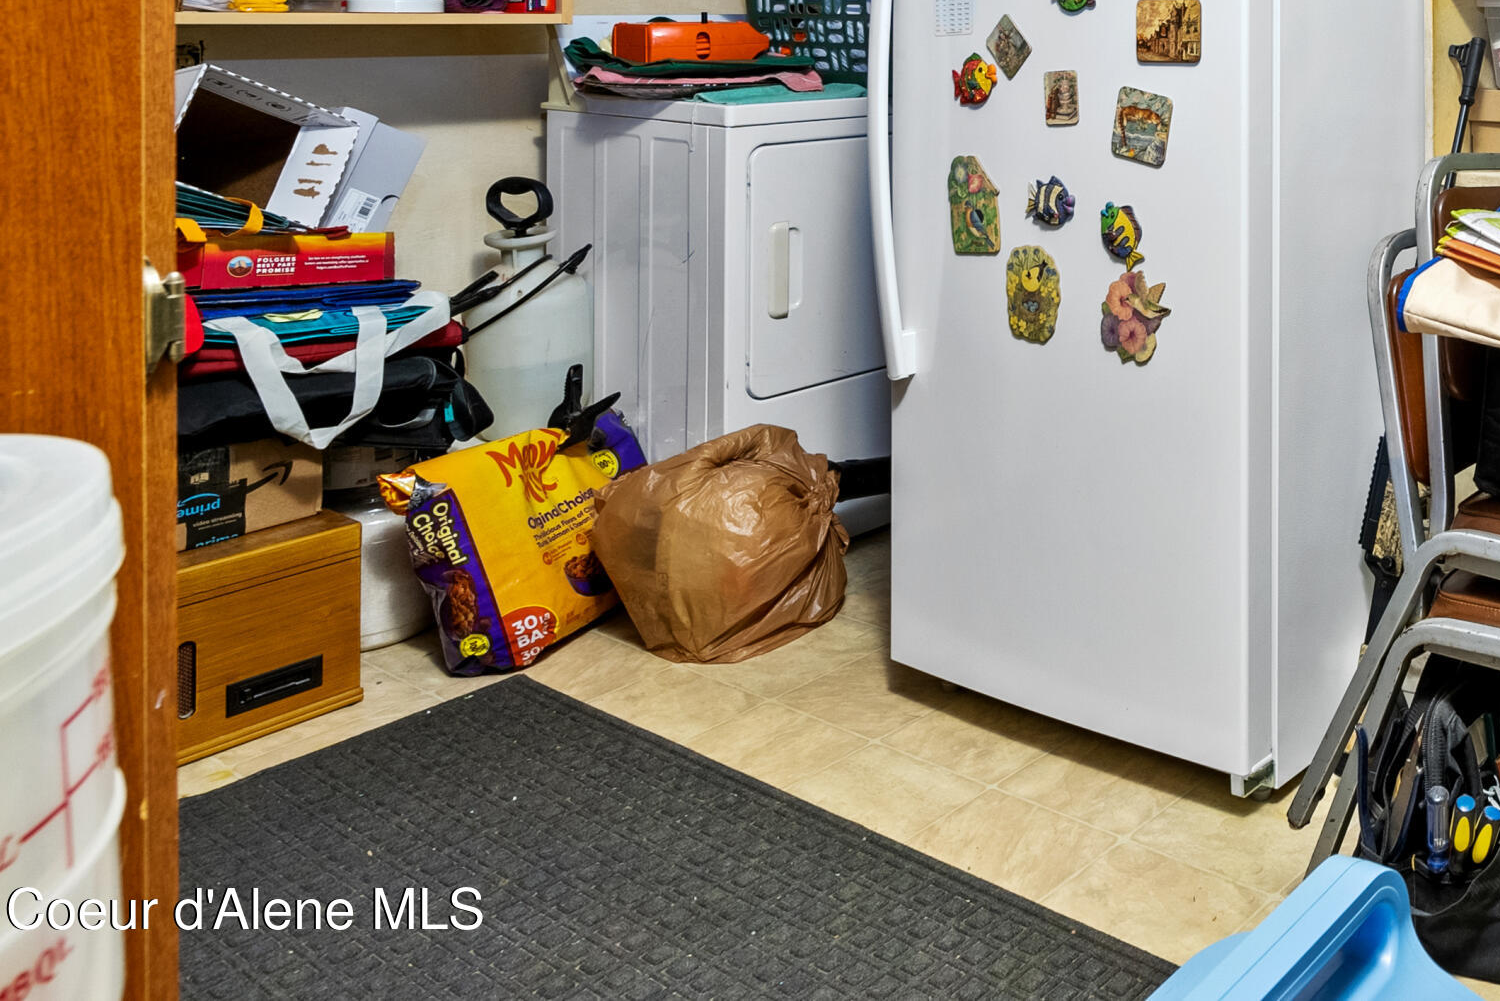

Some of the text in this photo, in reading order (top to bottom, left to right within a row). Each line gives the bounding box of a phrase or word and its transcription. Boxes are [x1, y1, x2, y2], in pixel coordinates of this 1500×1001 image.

[177, 498, 221, 518] prime
[412, 513, 446, 559] Choice
[432, 501, 468, 565] Original
[511, 614, 538, 636] 30
